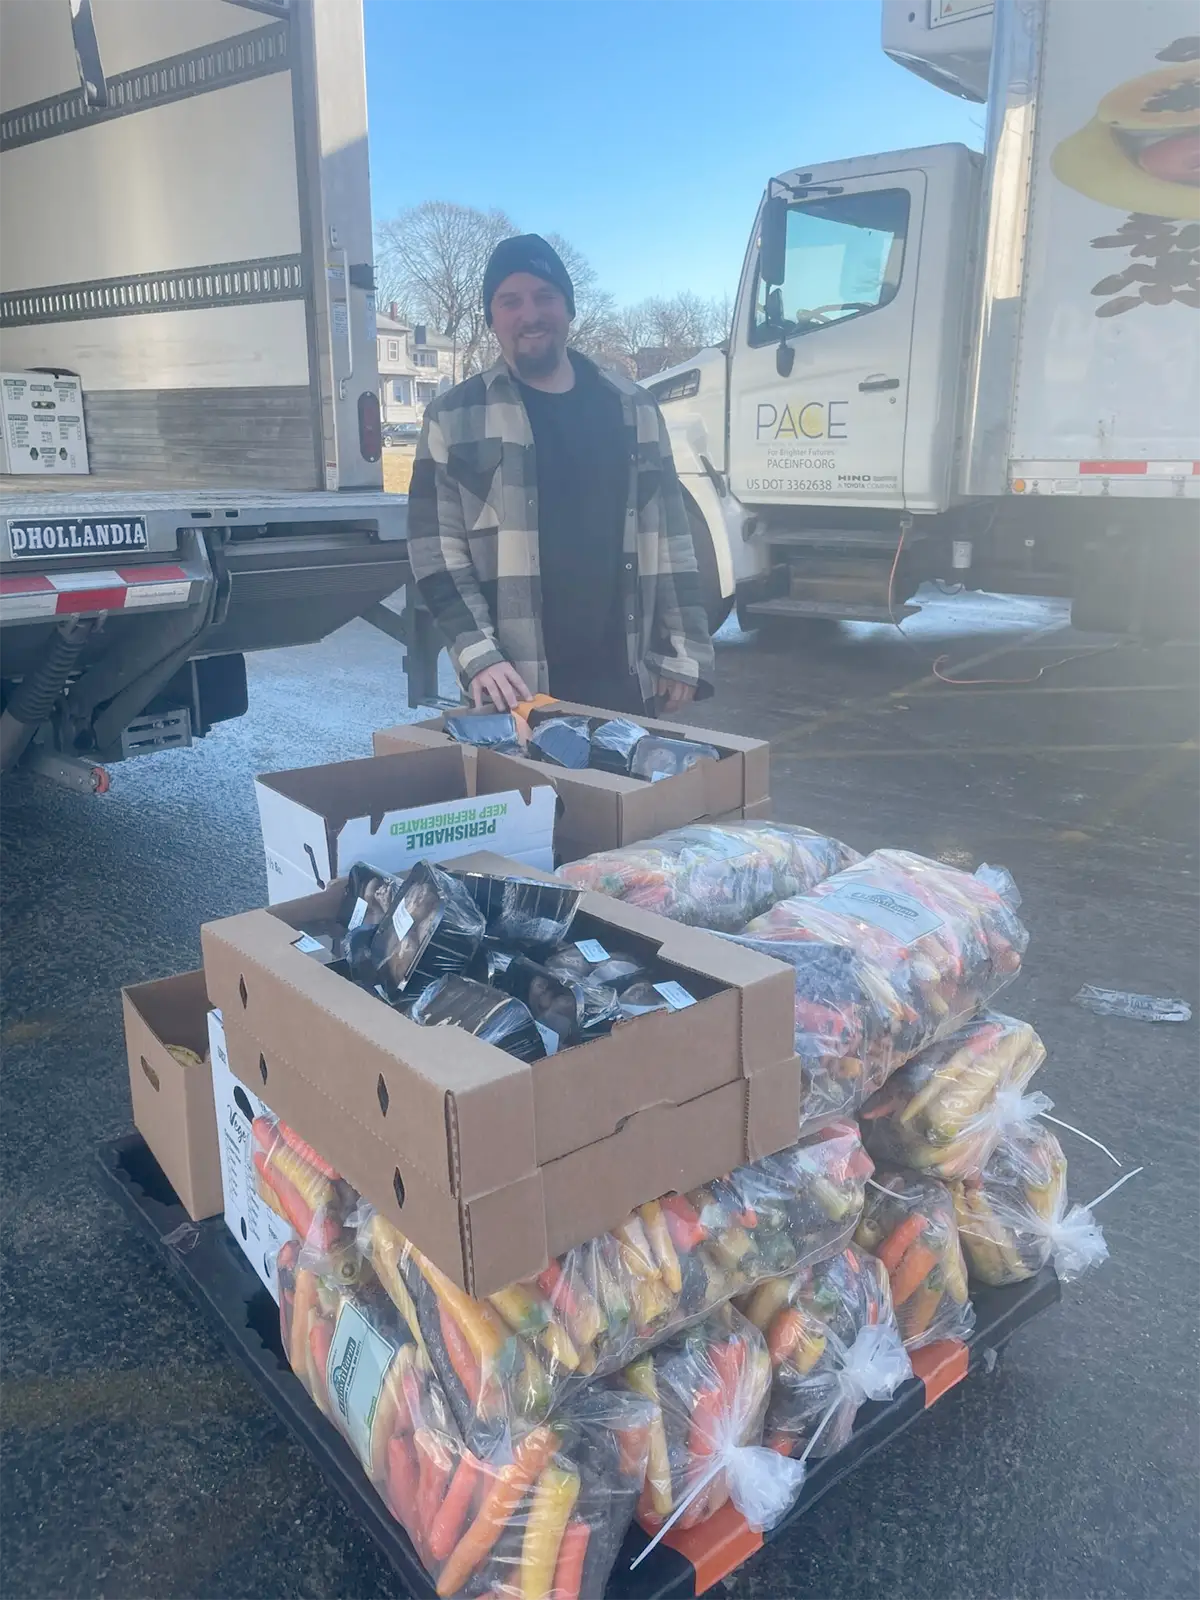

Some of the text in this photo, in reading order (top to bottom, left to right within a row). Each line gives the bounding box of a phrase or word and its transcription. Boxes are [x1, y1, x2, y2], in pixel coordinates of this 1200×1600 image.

[756, 401, 849, 440] PACE
[767, 448, 835, 457] For Brighter Futures
[767, 459, 836, 469] PACEINFO.ORG
[746, 479, 832, 491] US DOT 3362638
[11, 523, 146, 550] DHOLLANDIA
[389, 802, 508, 836] KEEP REFRIGERATED
[406, 818, 497, 851] PERISHABLE
